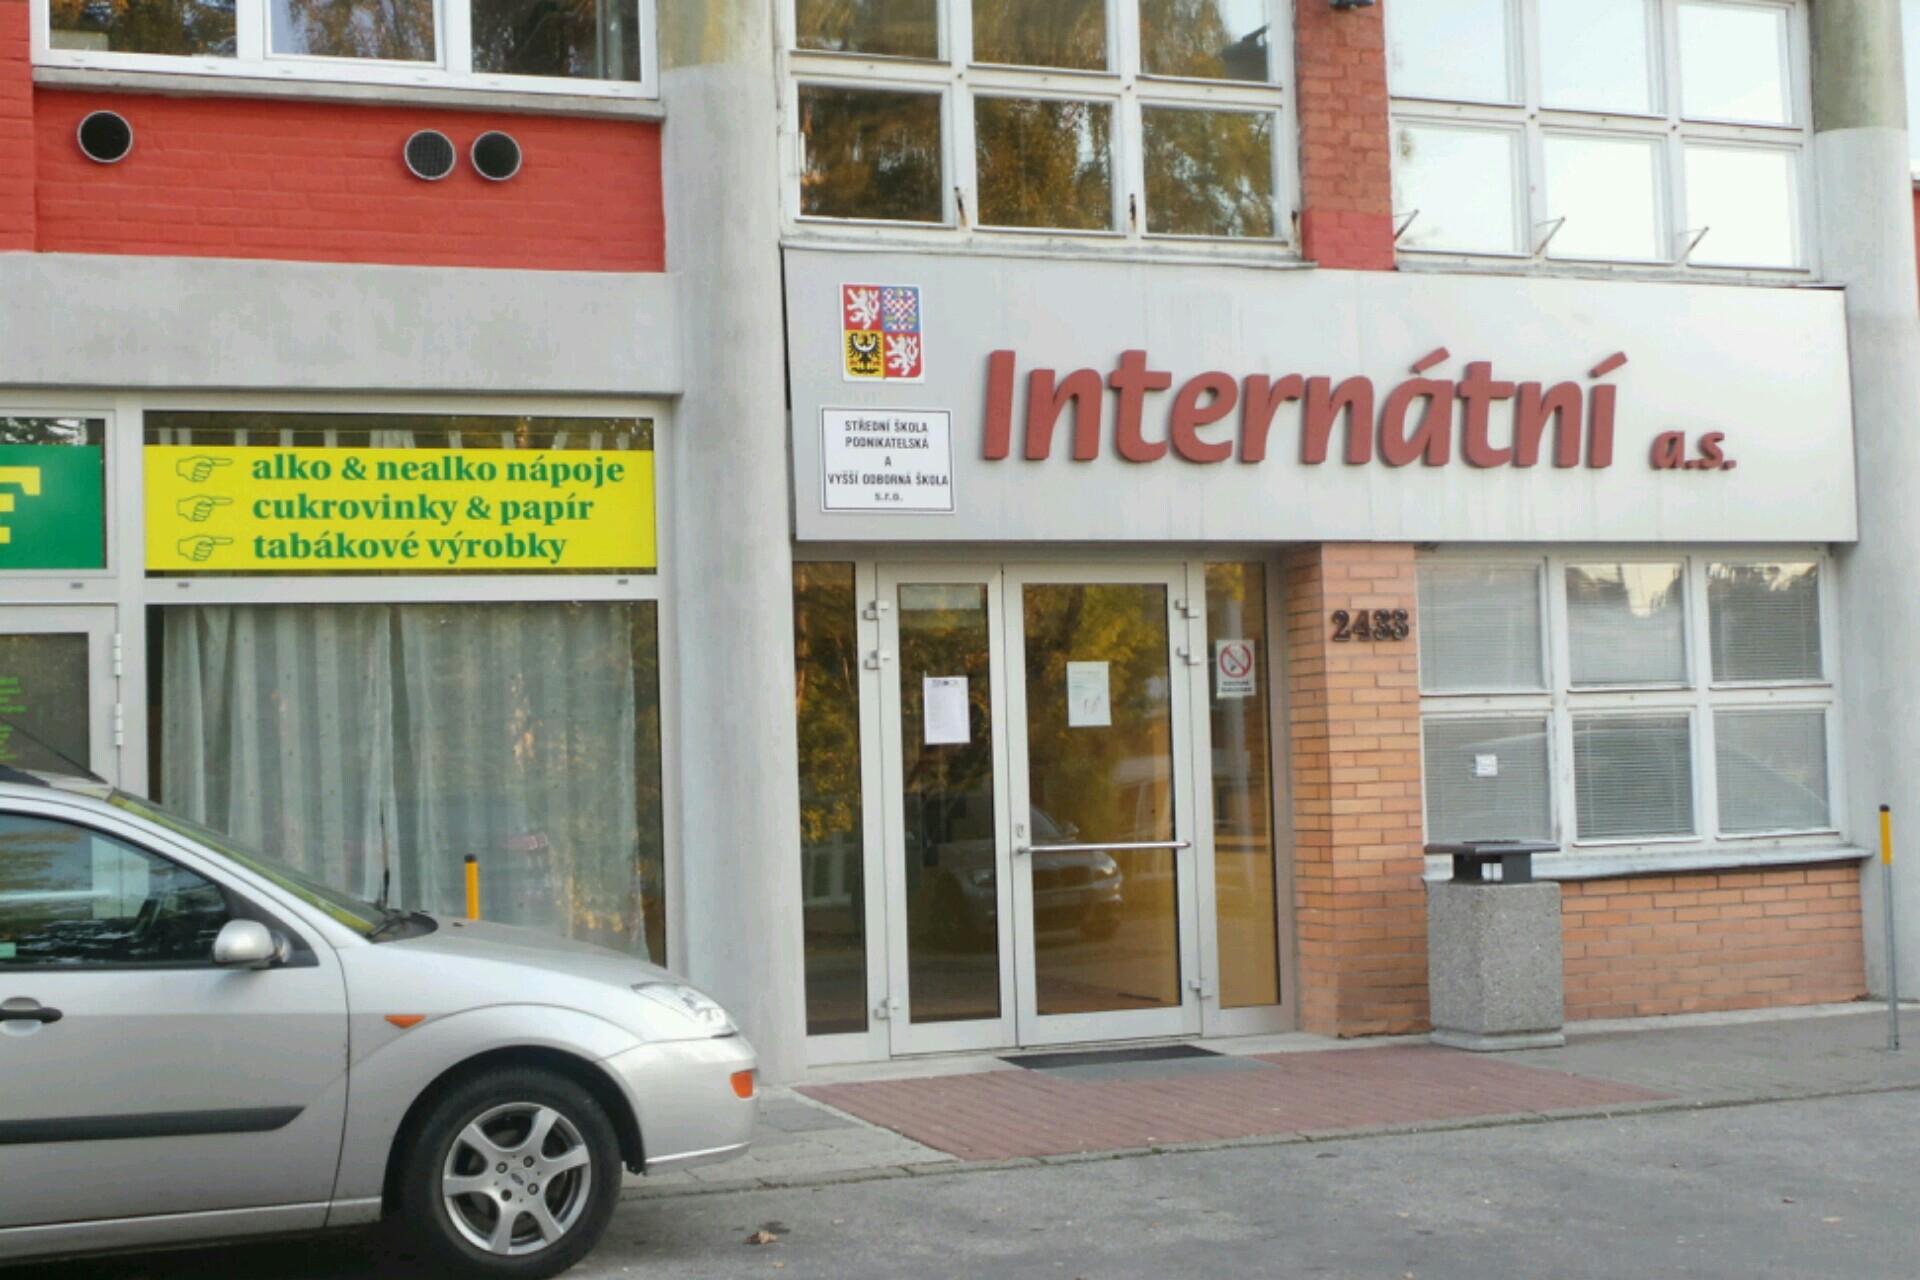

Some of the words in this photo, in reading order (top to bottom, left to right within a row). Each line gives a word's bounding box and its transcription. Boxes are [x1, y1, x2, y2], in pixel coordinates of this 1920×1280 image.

[845, 416, 890, 432] STŘEDNÍ
[894, 418, 928, 433] ŠKOLA
[982, 346, 1627, 468] Internátní
[1650, 430, 1737, 470] a.s.
[845, 435, 929, 449] PODNIKATELSKÁ
[252, 453, 332, 481] alko
[341, 456, 367, 480] &
[376, 455, 498, 482] nealko
[506, 454, 625, 488] nápoje
[884, 455, 892, 467] A
[828, 470, 859, 485] VYŠŠÍ
[862, 472, 912, 486] ODBORNÁ
[915, 471, 949, 487] ŠKOLA
[252, 493, 458, 526] cukrovinky
[465, 496, 491, 520] &
[499, 492, 594, 526] papír
[252, 531, 420, 559] tabákové
[427, 530, 567, 564] výrobky
[1331, 608, 1410, 643] 2433
